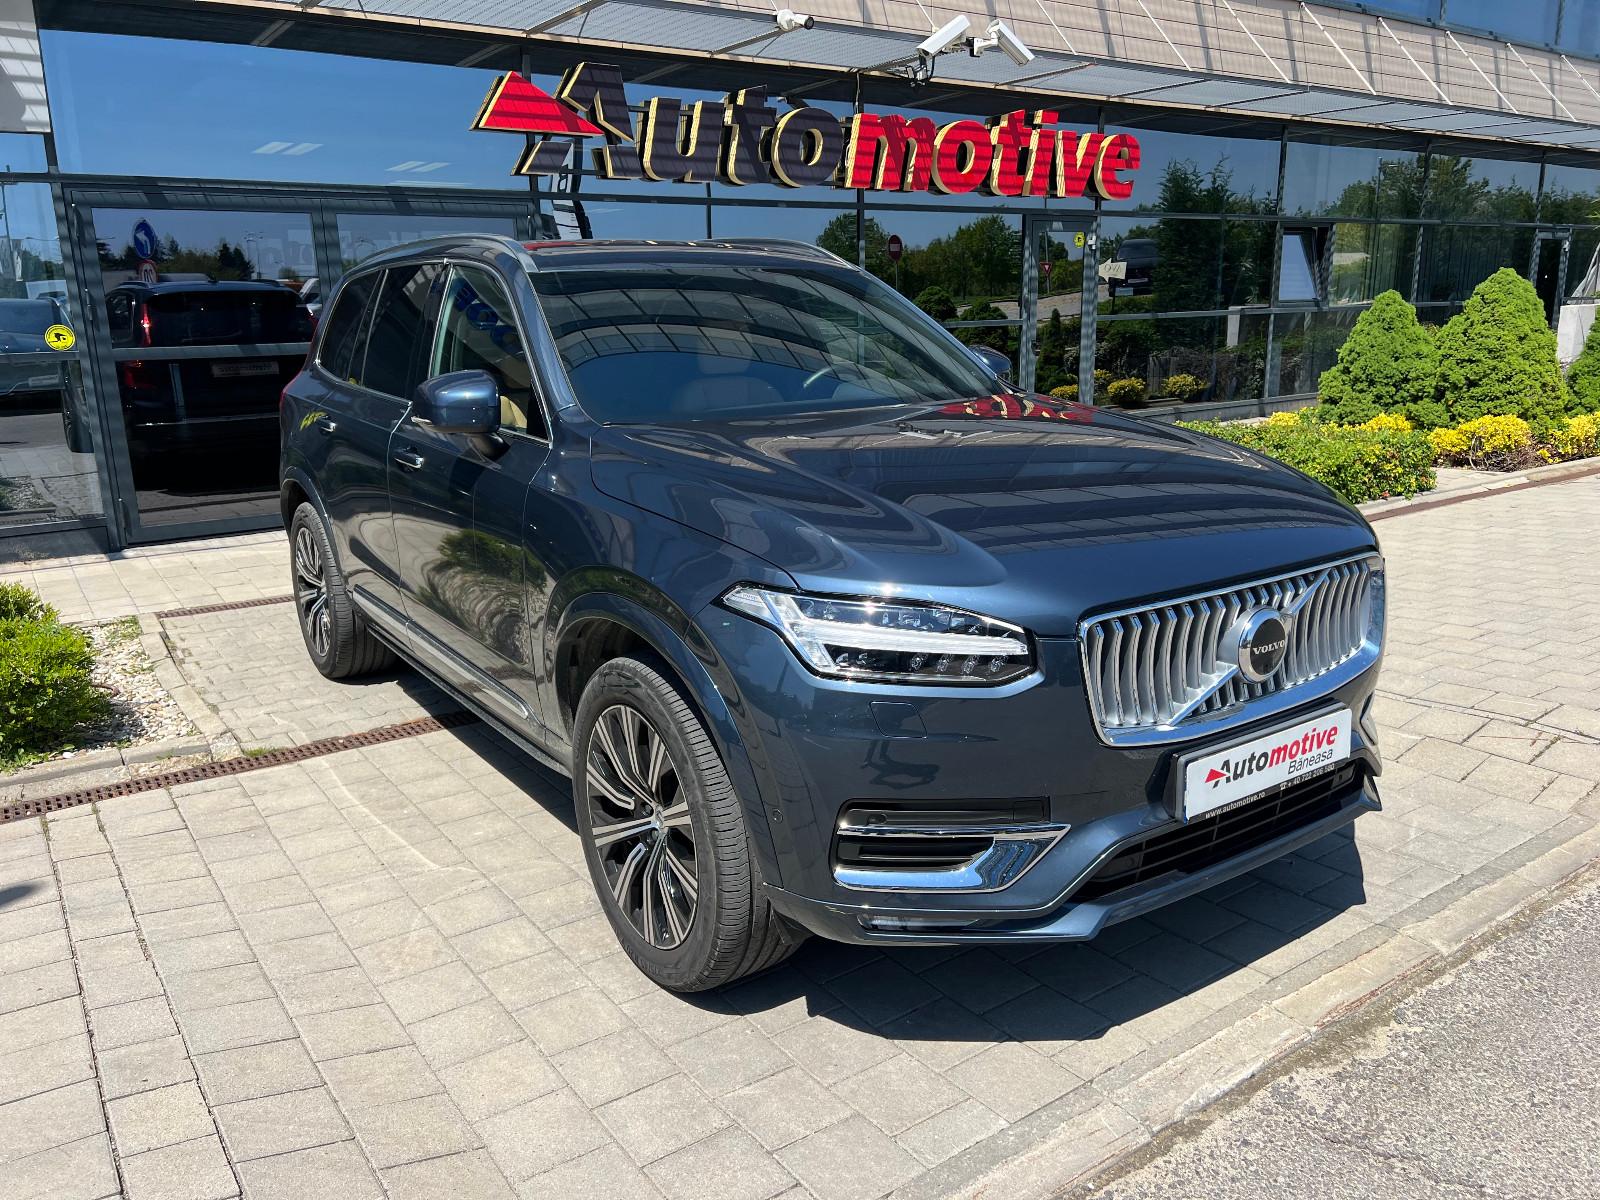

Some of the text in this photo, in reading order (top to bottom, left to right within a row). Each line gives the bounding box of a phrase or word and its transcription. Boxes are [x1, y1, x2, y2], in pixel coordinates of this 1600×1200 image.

[470, 62, 1141, 201] Automotive
[1252, 639, 1285, 655] VOLVO
[1205, 725, 1338, 789] Automotive
[1287, 748, 1333, 775] Băneasa
[1204, 791, 1266, 820] www.automotive.ro
